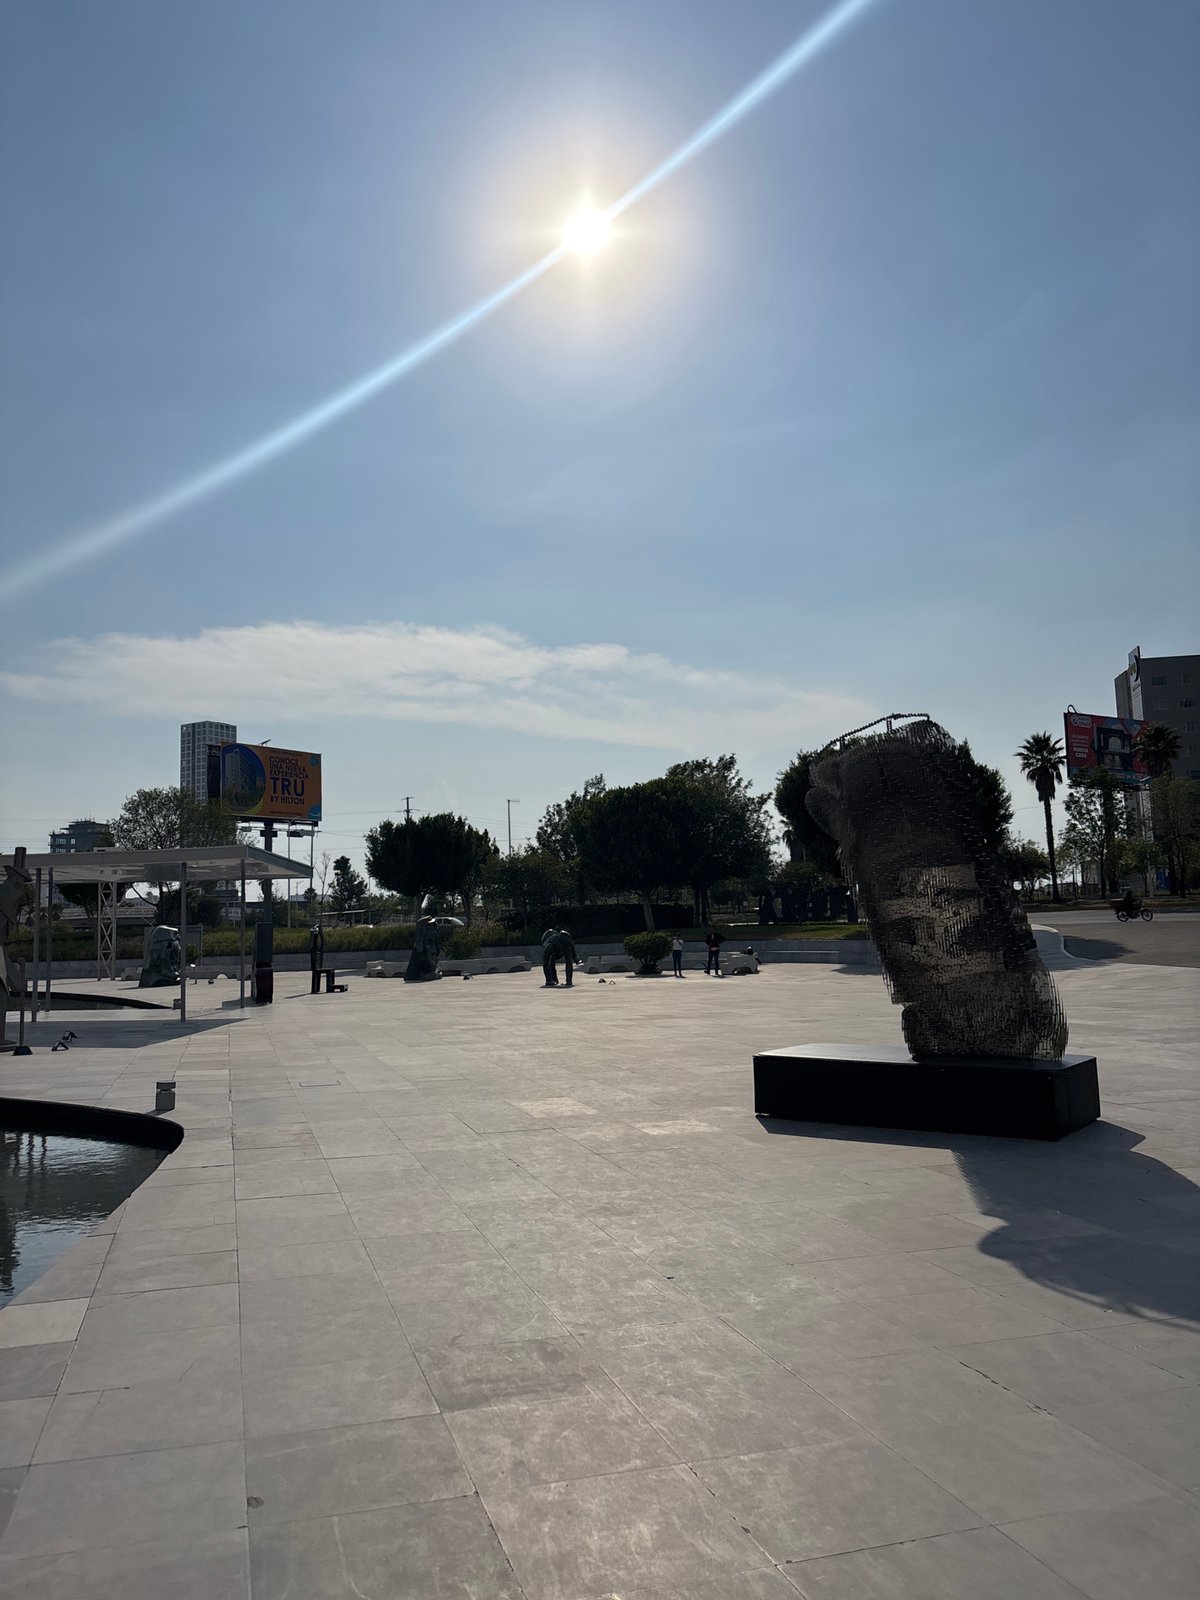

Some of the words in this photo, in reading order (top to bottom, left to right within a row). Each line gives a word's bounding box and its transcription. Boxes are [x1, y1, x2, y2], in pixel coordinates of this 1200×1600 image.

[270, 756, 298, 766] CONOCE
[286, 764, 306, 772] NUEVA
[270, 776, 305, 797] TRU
[281, 796, 305, 805] HILTON
